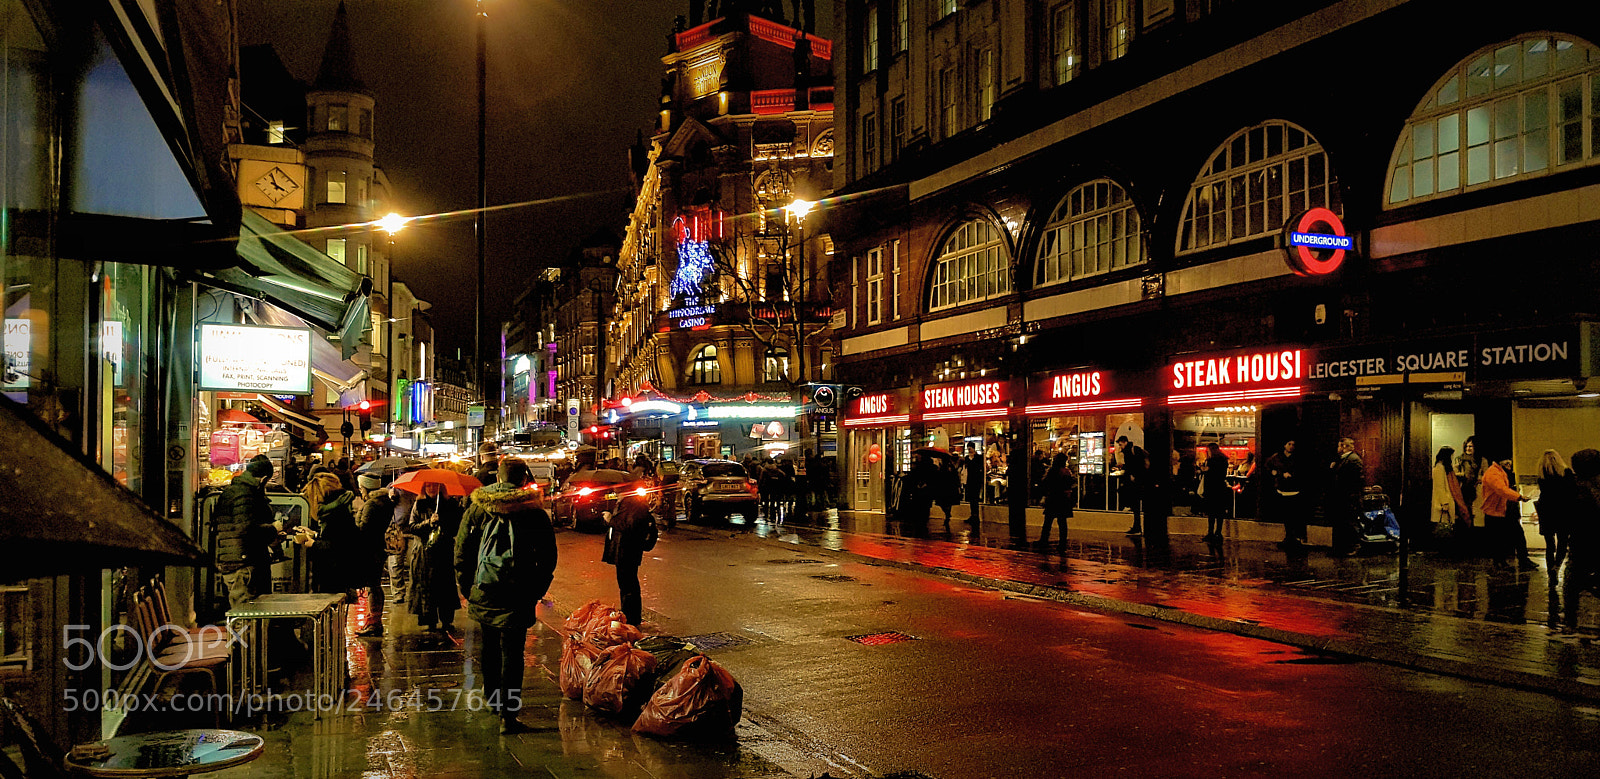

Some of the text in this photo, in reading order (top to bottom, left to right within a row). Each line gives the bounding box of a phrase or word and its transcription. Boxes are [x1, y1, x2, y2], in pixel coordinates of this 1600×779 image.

[1293, 233, 1349, 247] UNDERGROUND
[680, 317, 705, 328] CASINO
[1308, 341, 1568, 379] LEICESTER SQUARE STATION
[1173, 357, 1231, 389] STEAK
[237, 381, 274, 389] PHOTOCOPY
[924, 382, 1000, 409] STEAK HOUSES
[1052, 371, 1101, 399] ANGUS
[814, 406, 835, 414] ANGUS
[859, 394, 888, 415] ANGUS
